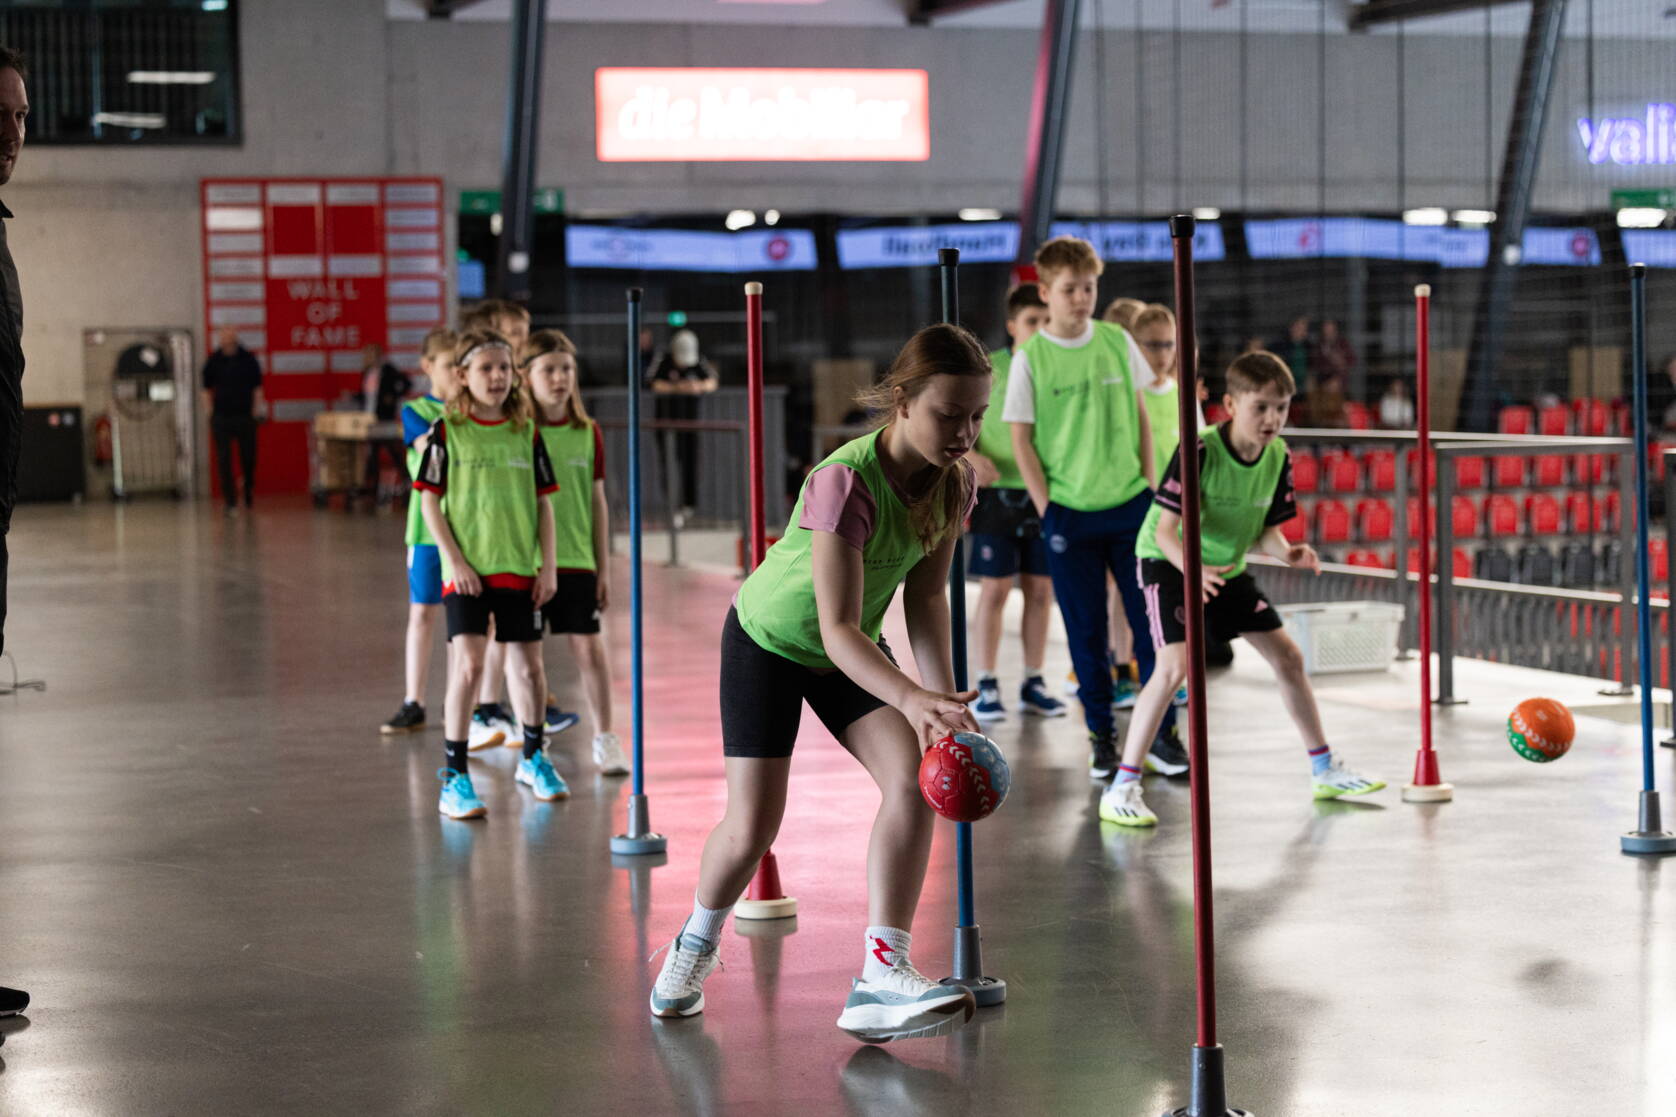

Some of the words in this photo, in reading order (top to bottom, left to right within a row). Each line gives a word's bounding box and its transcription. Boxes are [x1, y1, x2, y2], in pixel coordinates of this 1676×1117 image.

[617, 85, 697, 141] die
[1577, 103, 1676, 165] vali
[287, 279, 359, 300] WALL
[306, 301, 342, 324] OF
[291, 326, 360, 346] FAME
